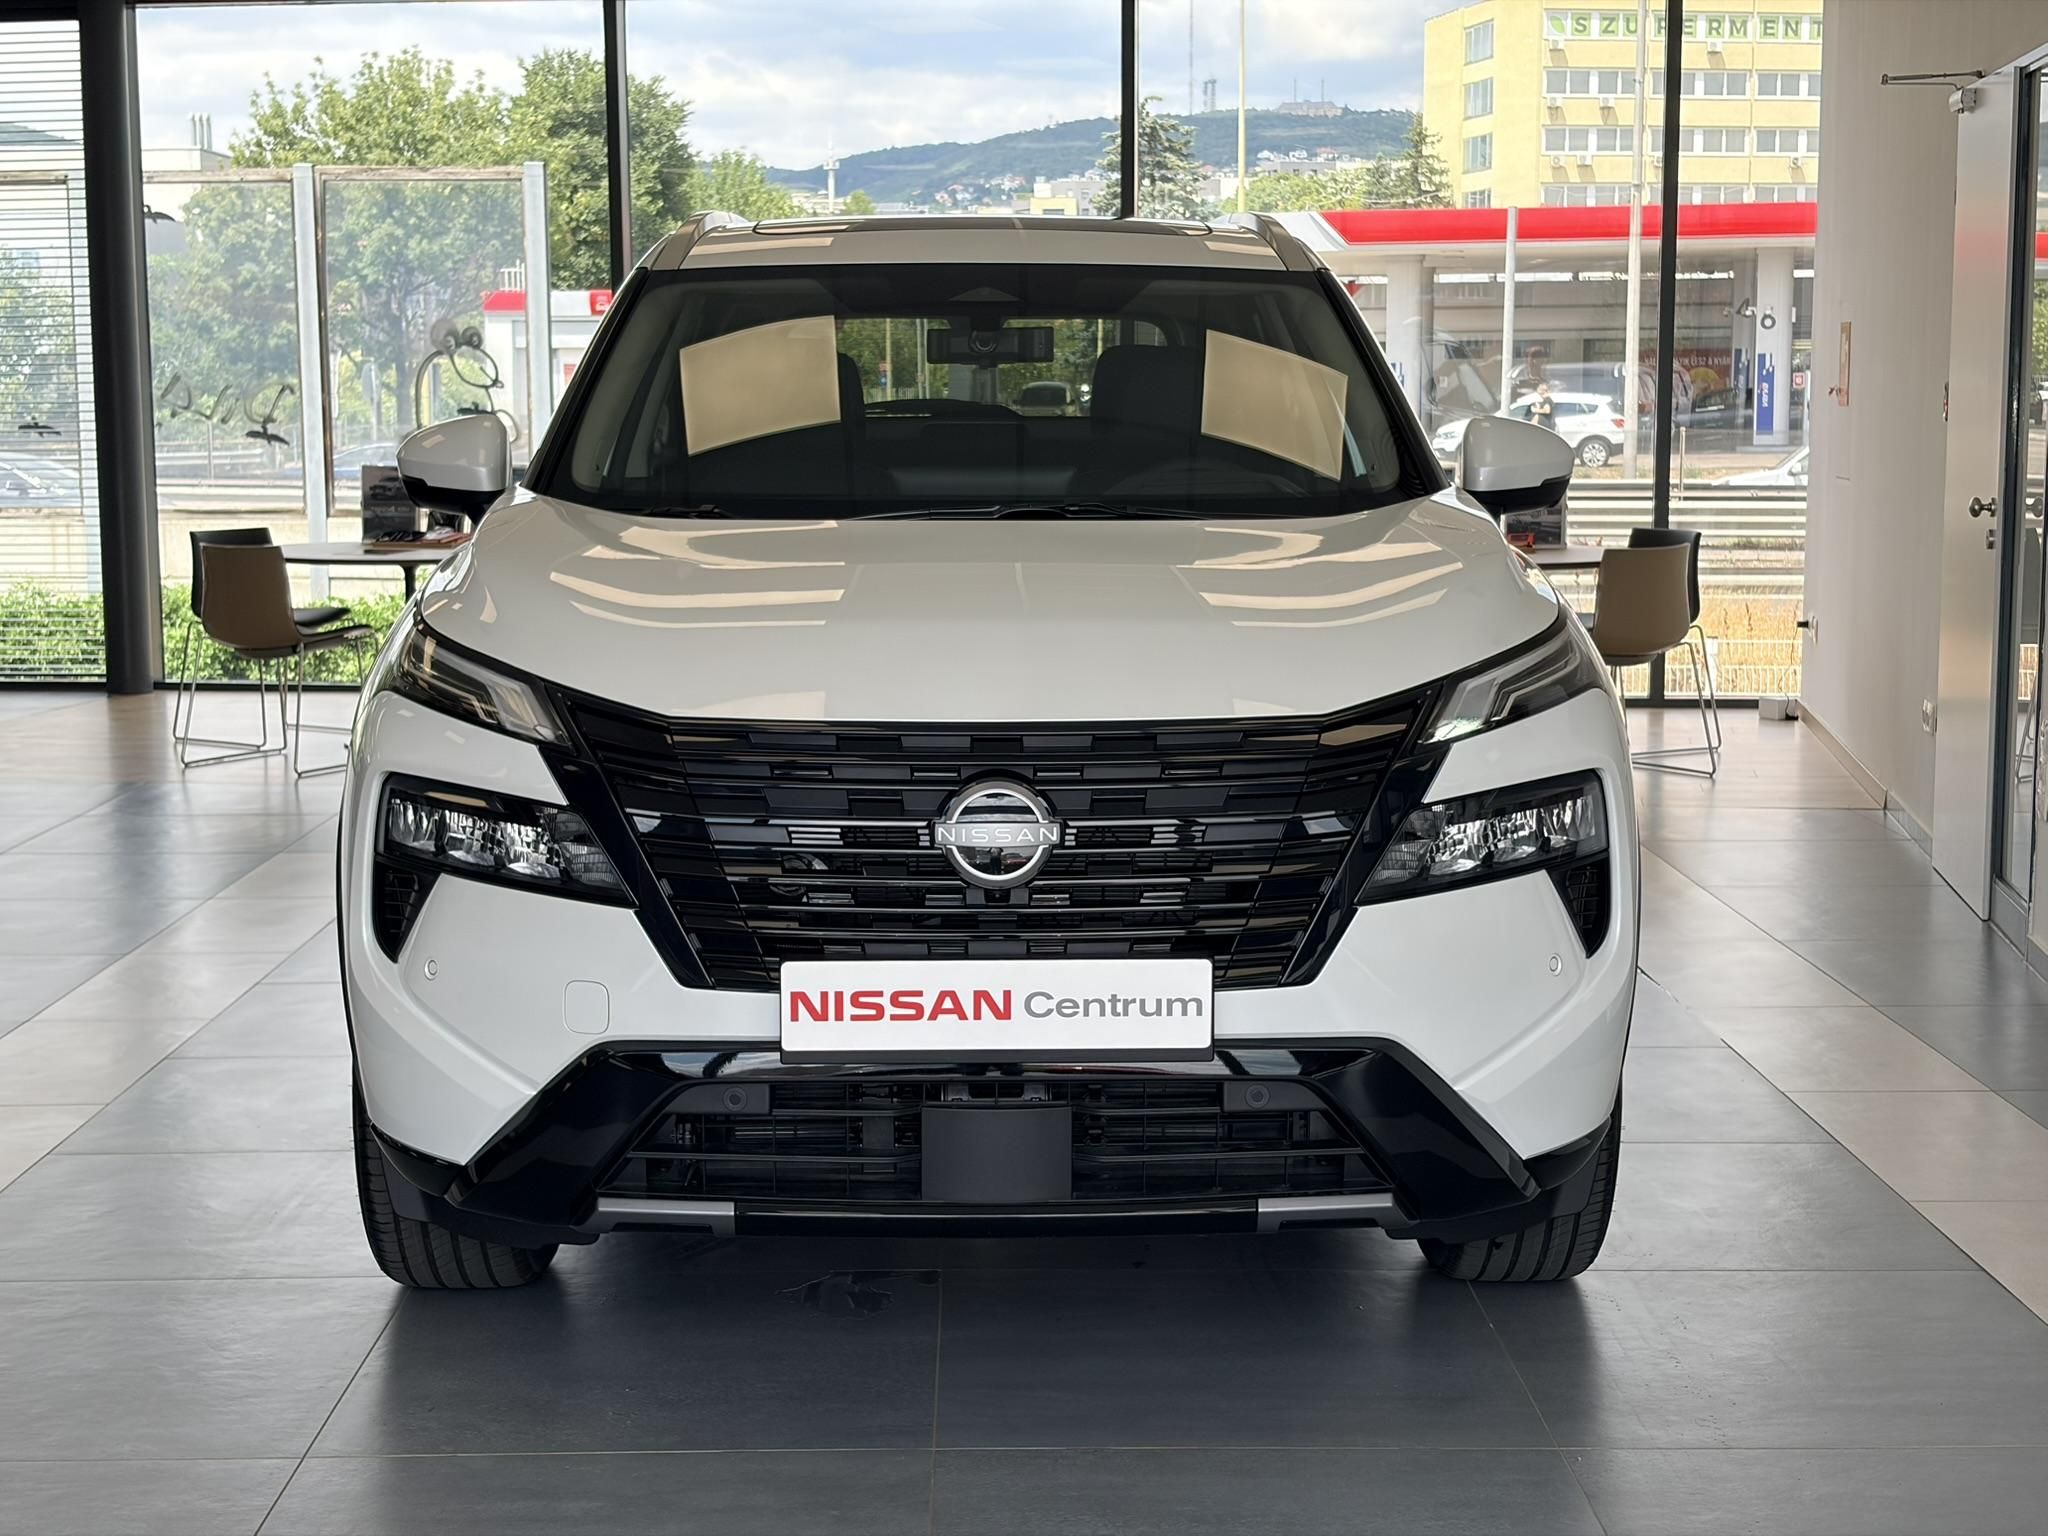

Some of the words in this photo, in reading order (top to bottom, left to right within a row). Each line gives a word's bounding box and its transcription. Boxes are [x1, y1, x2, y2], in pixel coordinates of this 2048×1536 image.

[937, 826, 1059, 843] NISSAN
[789, 989, 1012, 1022] NISSAN
[1024, 990, 1203, 1018] Centrum
